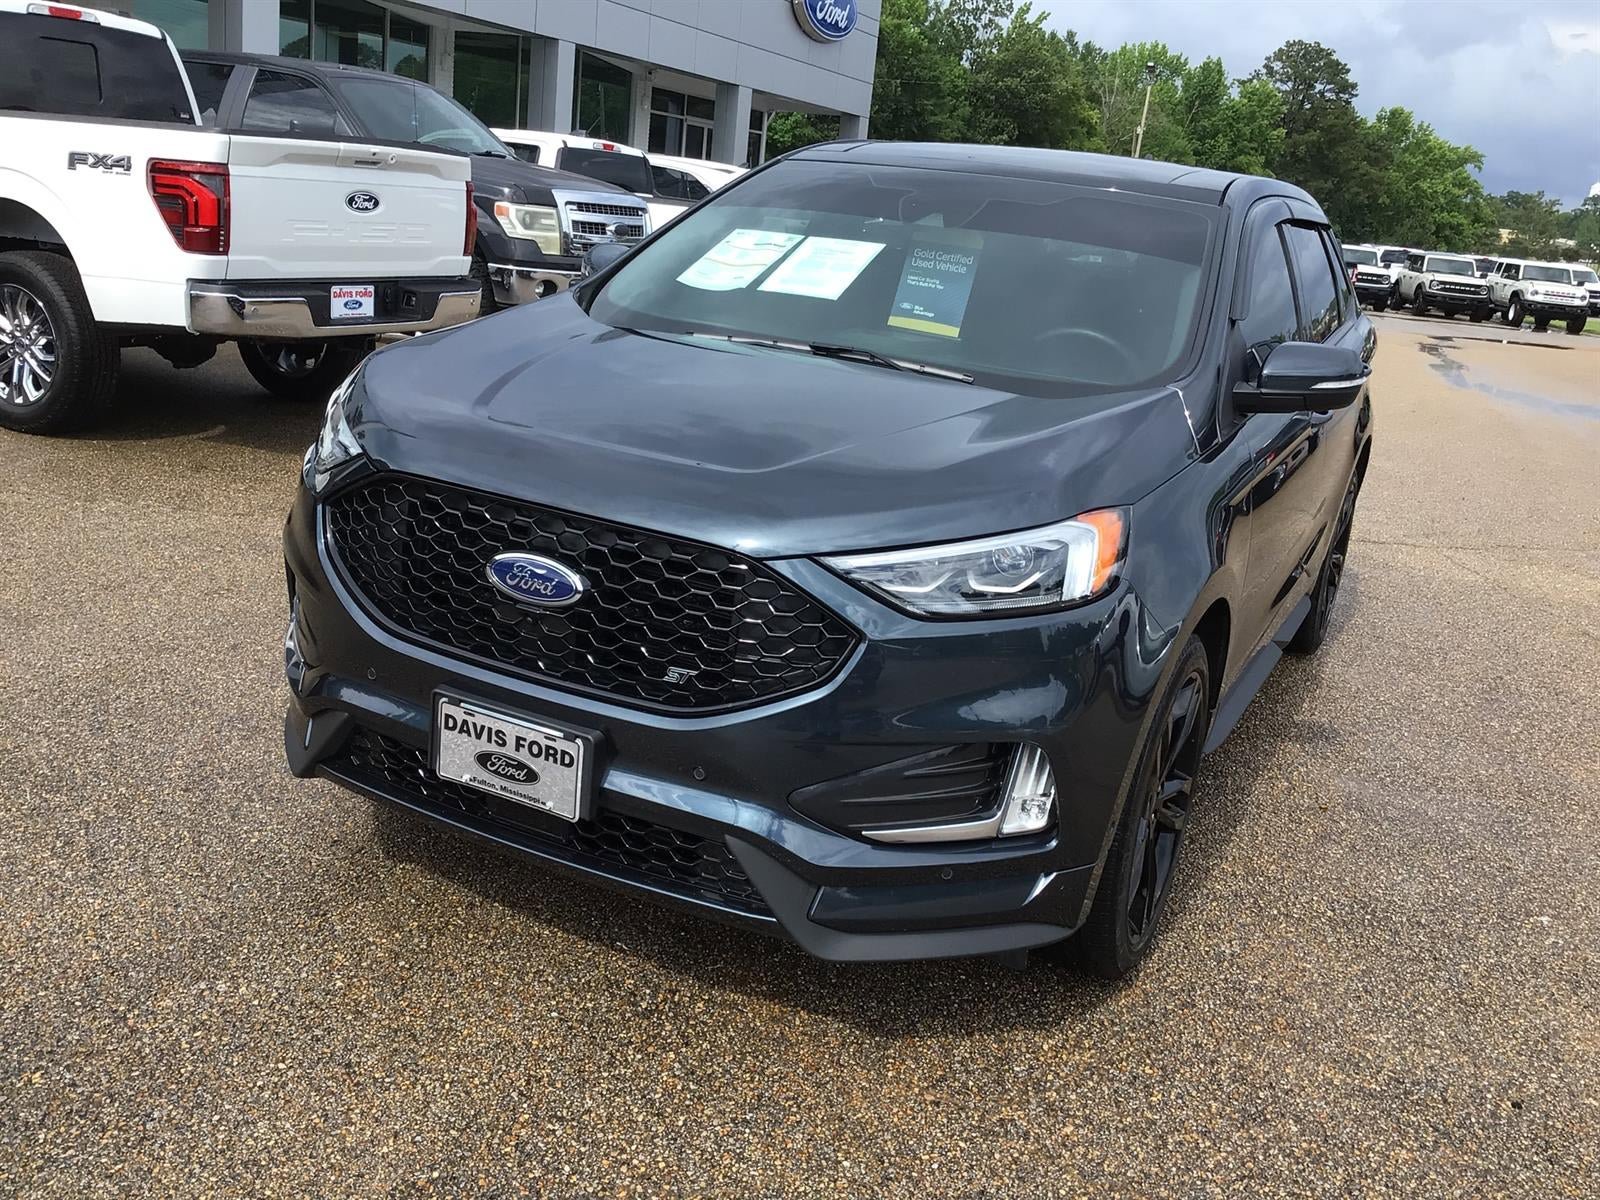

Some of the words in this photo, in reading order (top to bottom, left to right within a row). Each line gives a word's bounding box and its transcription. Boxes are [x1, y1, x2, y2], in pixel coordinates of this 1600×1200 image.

[816, 0, 851, 29] Ford
[67, 151, 132, 171] FX4
[352, 194, 375, 209] Ford
[911, 257, 934, 269] Used
[936, 261, 967, 274] Vehicle
[914, 248, 935, 259] Gold
[936, 251, 974, 265] Certified
[333, 290, 353, 298] DAVIS
[355, 290, 373, 298] FORD
[505, 562, 557, 596] Ford
[663, 666, 699, 684] ST
[443, 712, 508, 748] DAVIS
[514, 735, 576, 769] FORD
[486, 754, 528, 782] Ford
[500, 784, 541, 805] Mississippi
